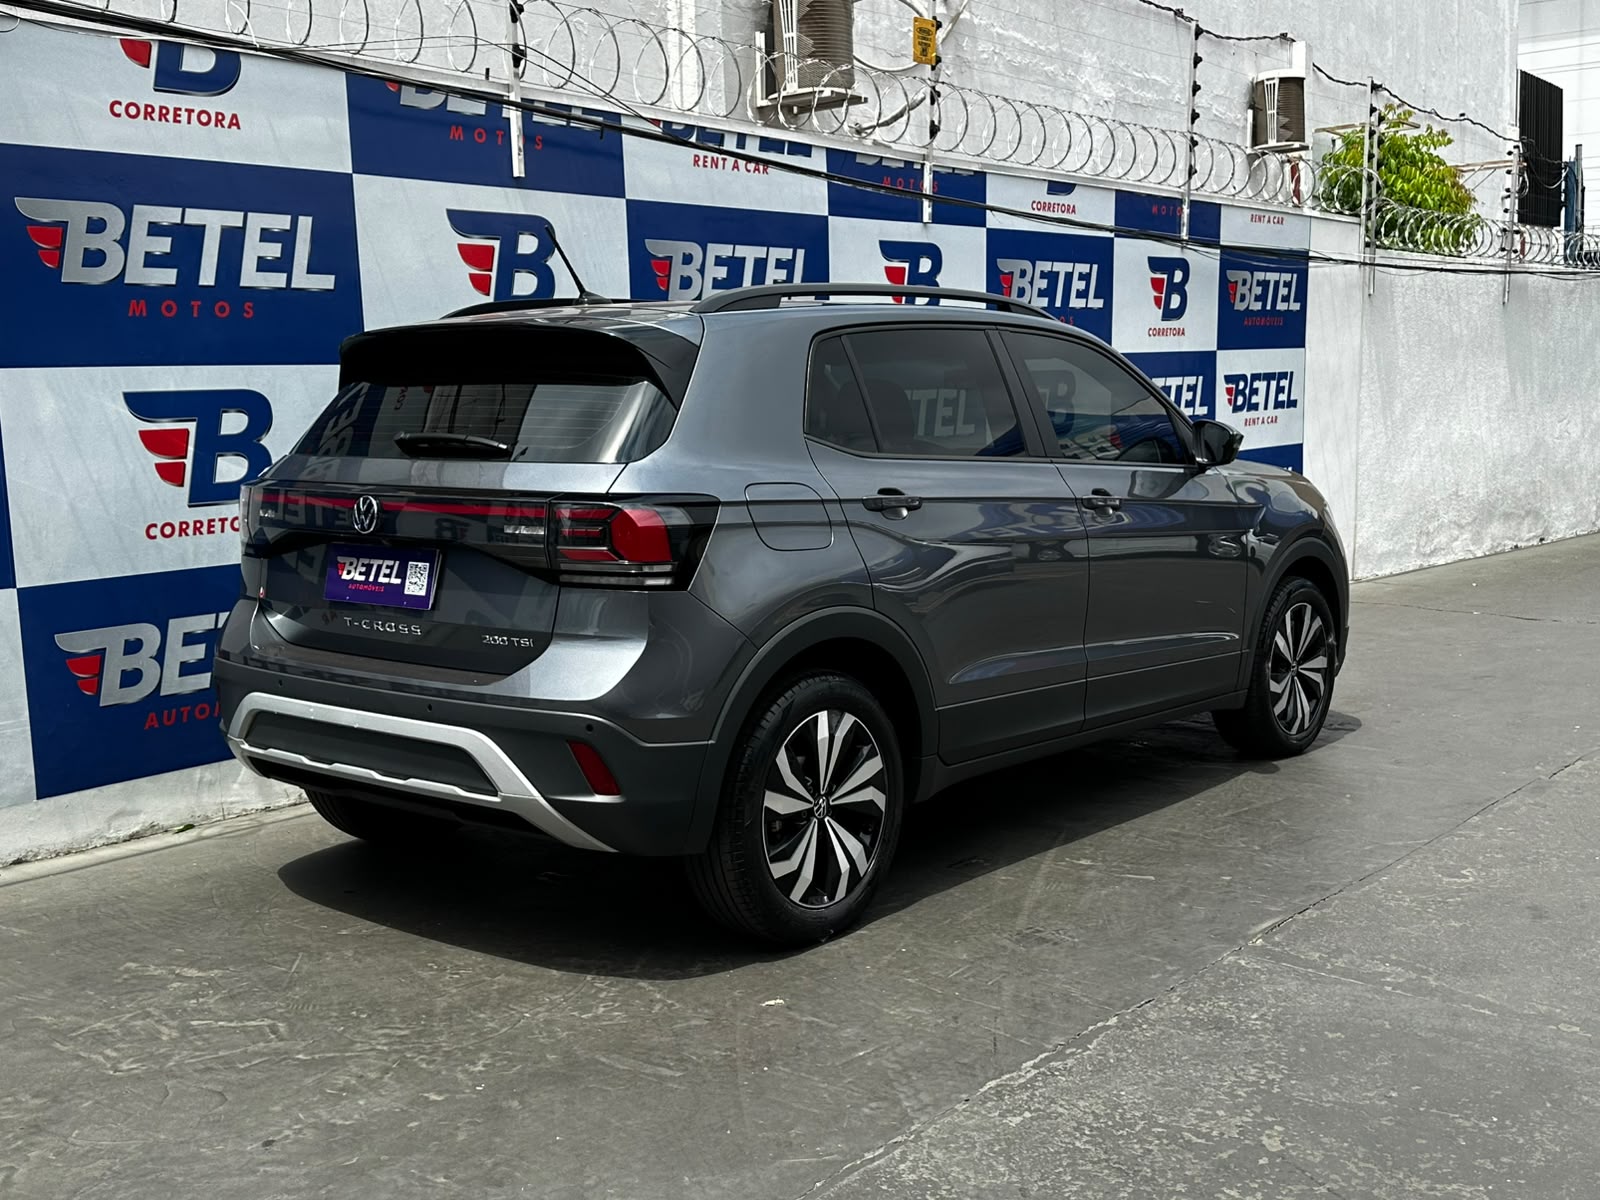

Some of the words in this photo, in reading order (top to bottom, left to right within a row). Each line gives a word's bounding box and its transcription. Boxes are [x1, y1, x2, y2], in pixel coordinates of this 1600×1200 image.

[109, 99, 241, 130] CORRETORA
[450, 125, 543, 150] MOTS
[693, 154, 728, 170] RENT
[732, 159, 740, 172] A
[745, 161, 769, 175] CAR
[1031, 200, 1076, 214] CORRETORA
[1250, 213, 1266, 224] RENT
[1267, 215, 1271, 225] A
[1272, 216, 1285, 225] CAR
[14, 197, 336, 290] BETEL
[644, 239, 815, 304] BETEL
[997, 258, 1104, 308] BETEL
[1226, 270, 1301, 311] BETEL
[128, 299, 254, 318] MOTOS
[1147, 327, 1186, 337] CORRETORA
[1152, 375, 1208, 416] TEL
[1223, 371, 1298, 414] BETEL
[1244, 417, 1260, 427] RENT
[1261, 416, 1265, 425] A
[1266, 415, 1278, 424] CAR
[336, 555, 402, 585] BETEL
[343, 617, 422, 636] T-CROSS
[482, 635, 509, 647] 200
[511, 637, 534, 648] TSI
[54, 611, 231, 707] BE
